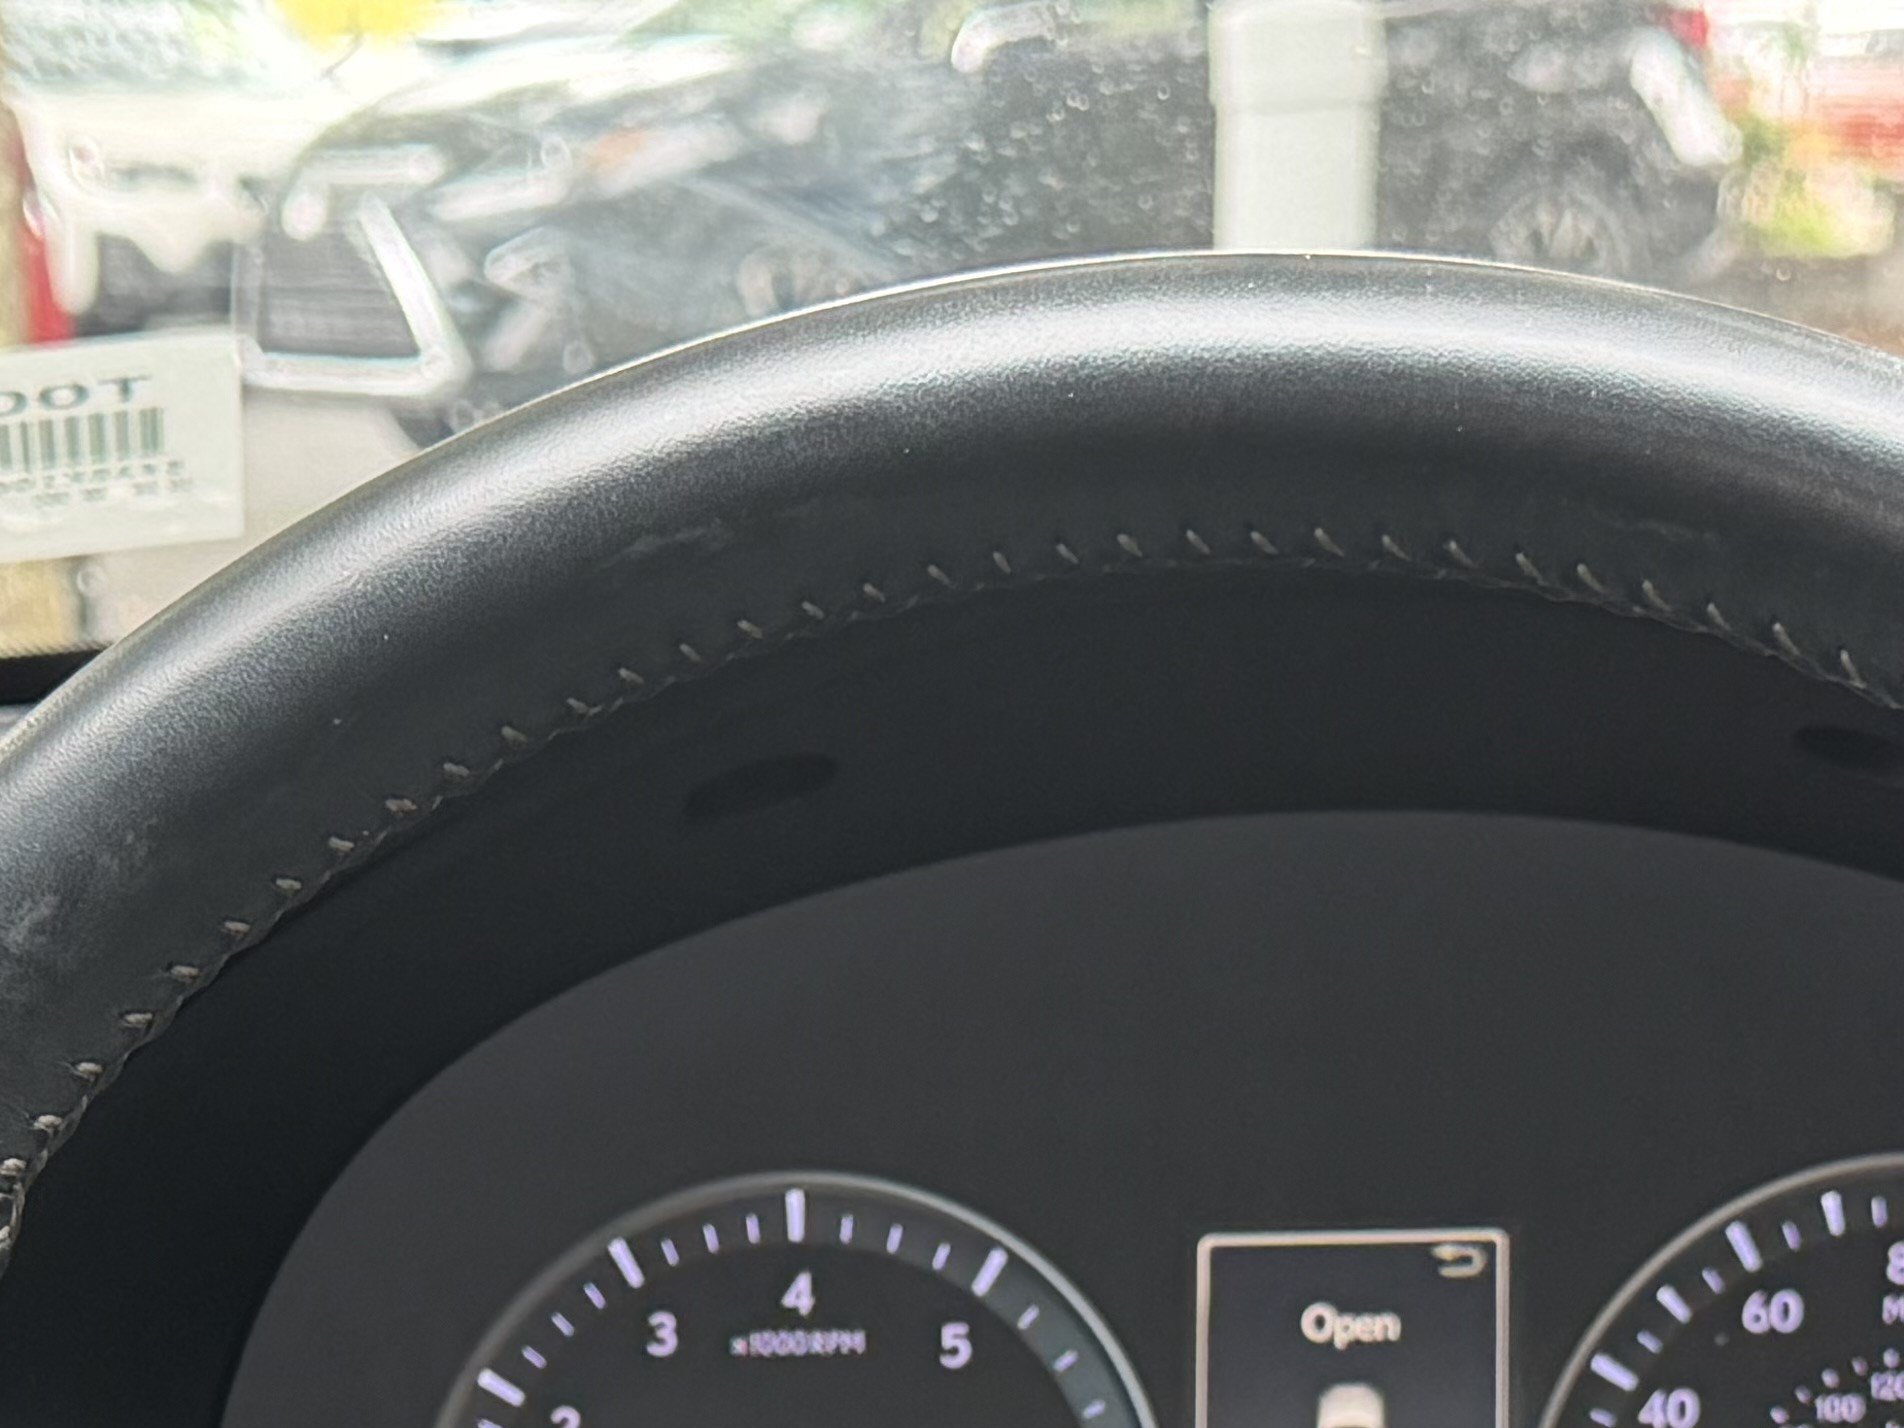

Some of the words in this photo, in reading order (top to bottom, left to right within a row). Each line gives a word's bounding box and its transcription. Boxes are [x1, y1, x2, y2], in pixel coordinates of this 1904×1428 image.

[781, 1269, 816, 1317] 4
[1741, 1289, 1804, 1335] 60
[645, 1311, 679, 1357] 3
[939, 1322, 973, 1369] 5
[1300, 1301, 1401, 1350] Open
[1815, 1393, 1867, 1424] 100
